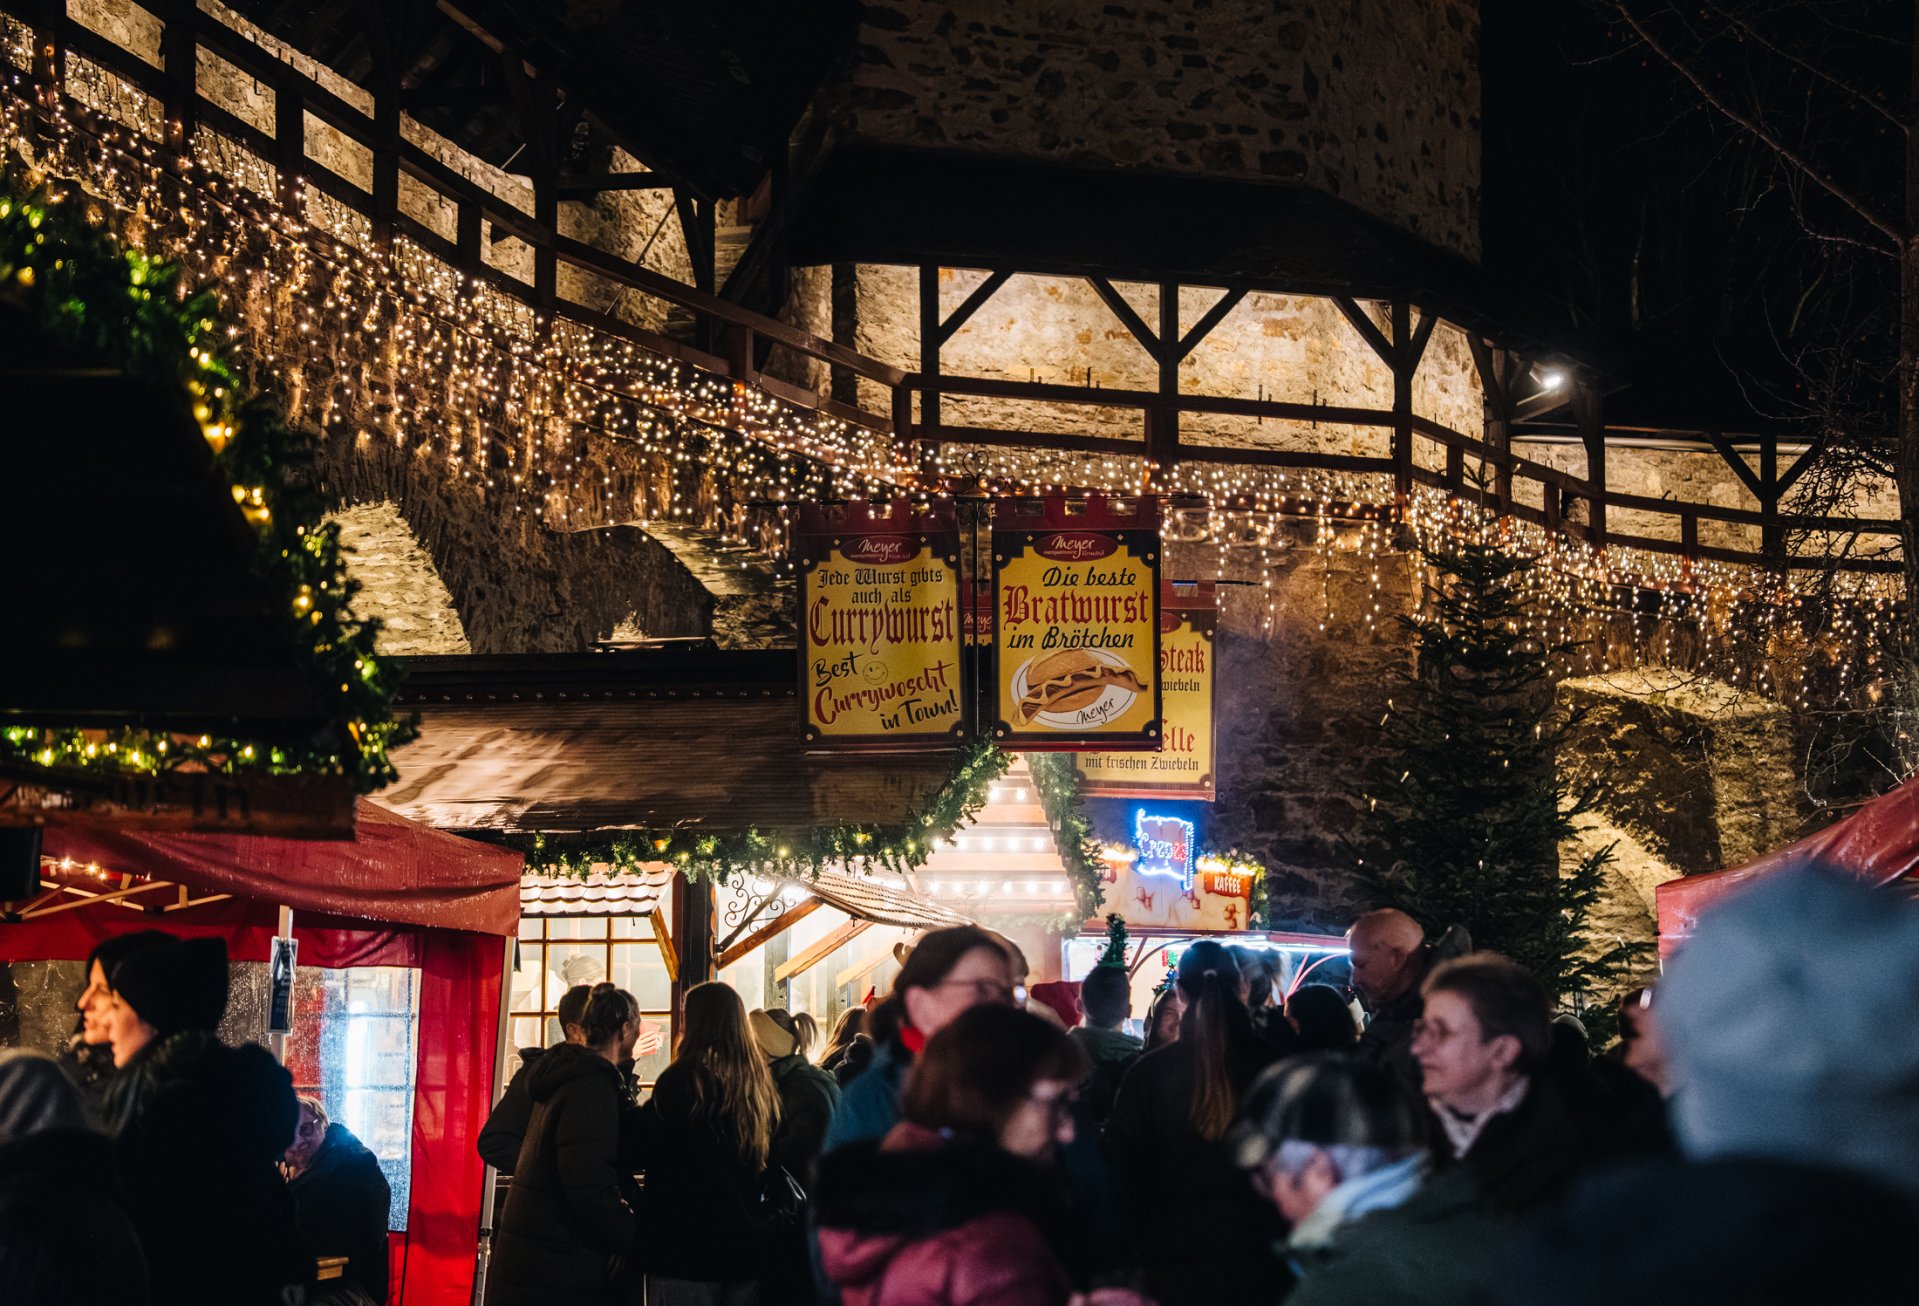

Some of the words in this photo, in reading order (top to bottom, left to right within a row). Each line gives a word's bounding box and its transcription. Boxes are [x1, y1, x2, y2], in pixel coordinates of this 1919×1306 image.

[858, 540, 902, 562] Meyer
[1051, 536, 1096, 559] Meyer
[817, 569, 850, 588] Jede
[855, 568, 906, 585] Wurst
[910, 567, 943, 586] gibts
[1042, 566, 1079, 587] Die
[1084, 566, 1137, 586] beste
[851, 589, 882, 606] auch
[891, 588, 911, 603] als
[1003, 584, 1149, 631] Bratwurst
[810, 596, 954, 655] Currywurst
[1007, 626, 1034, 648] im
[1041, 626, 1134, 650] Brötchen
[811, 651, 864, 687] Best
[815, 660, 955, 725] Currywoscht
[1161, 679, 1200, 692] wiebeln
[880, 713, 900, 730] in
[898, 689, 959, 725] Town!
[1077, 697, 1114, 724] Meyer
[1085, 756, 1103, 769] mit
[1106, 756, 1147, 773] frischen
[1150, 756, 1199, 771] Zwiebeln
[1214, 875, 1241, 894] KAFFEE
